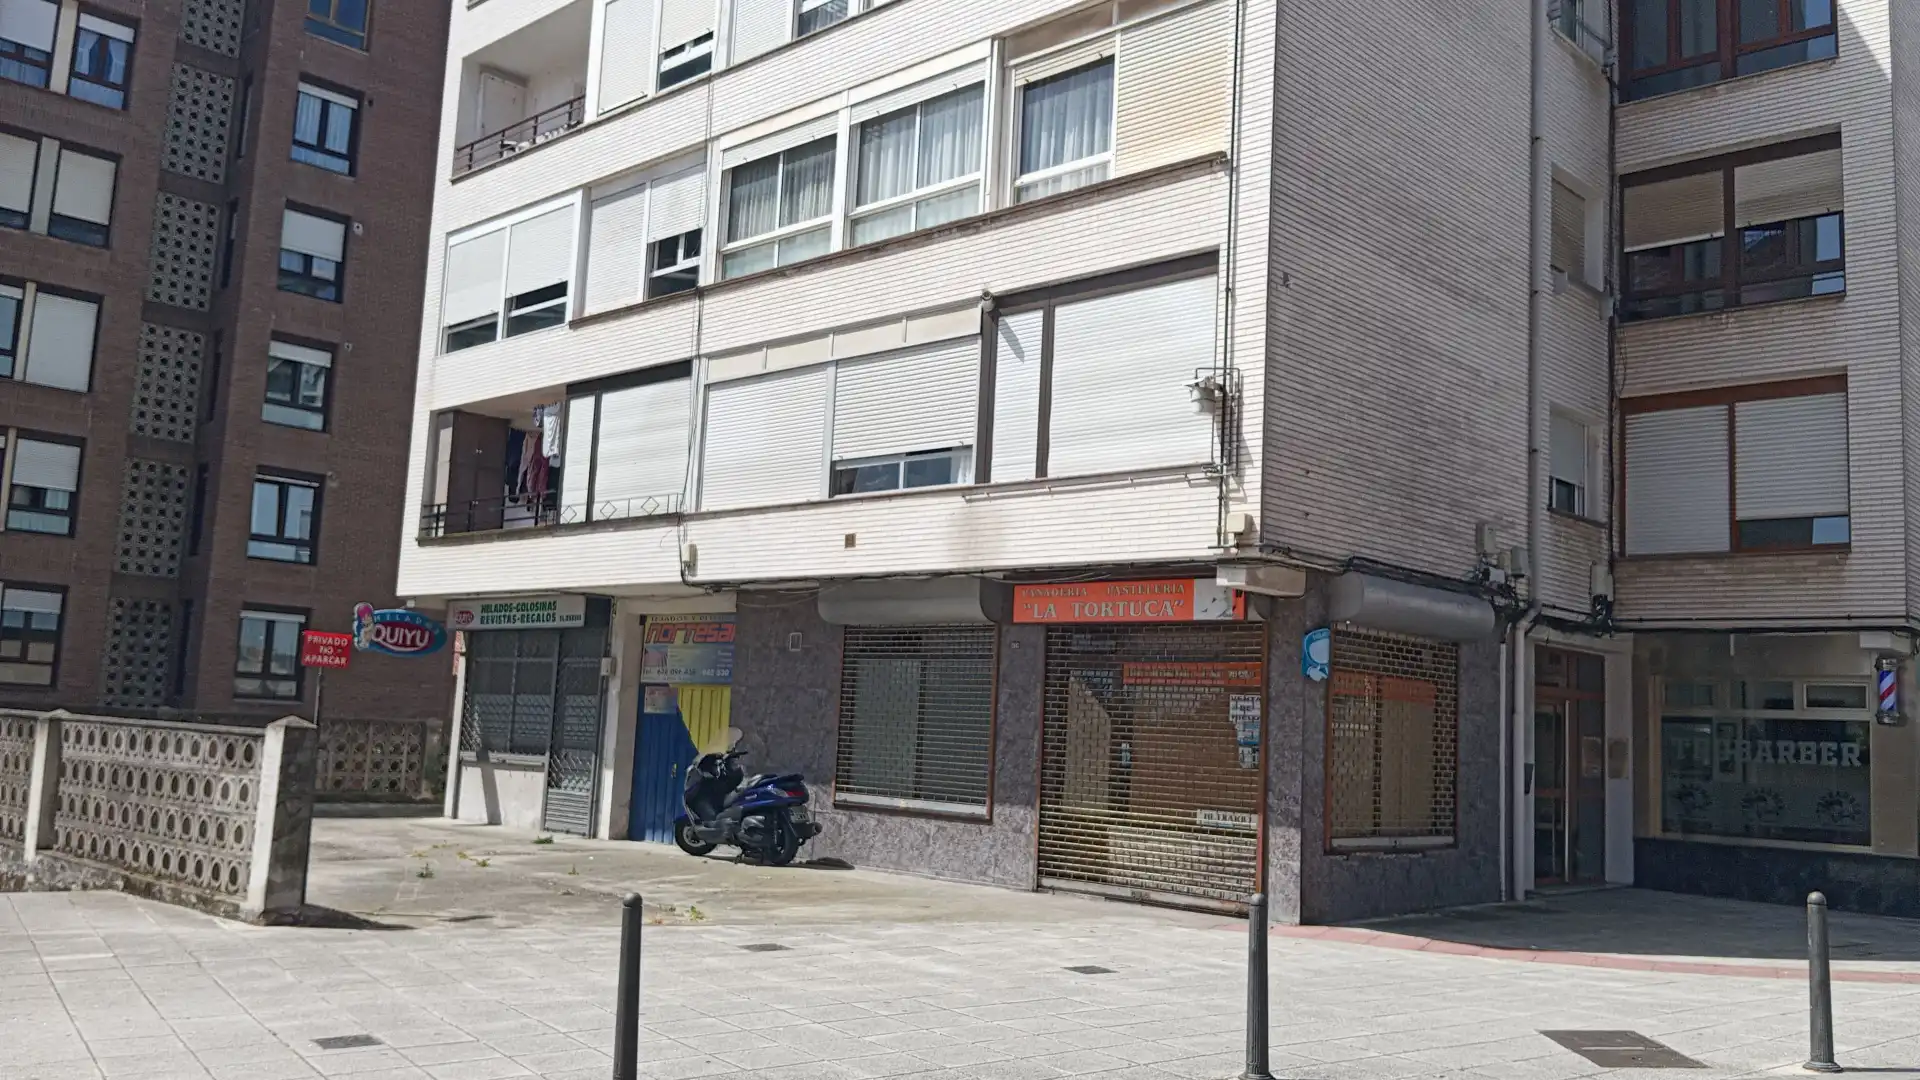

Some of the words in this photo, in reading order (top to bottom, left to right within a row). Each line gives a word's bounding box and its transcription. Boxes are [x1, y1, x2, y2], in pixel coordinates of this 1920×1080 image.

[307, 634, 349, 647] PRIVADO
[371, 623, 430, 647] QUIYU
[304, 654, 347, 666] APARCAR
